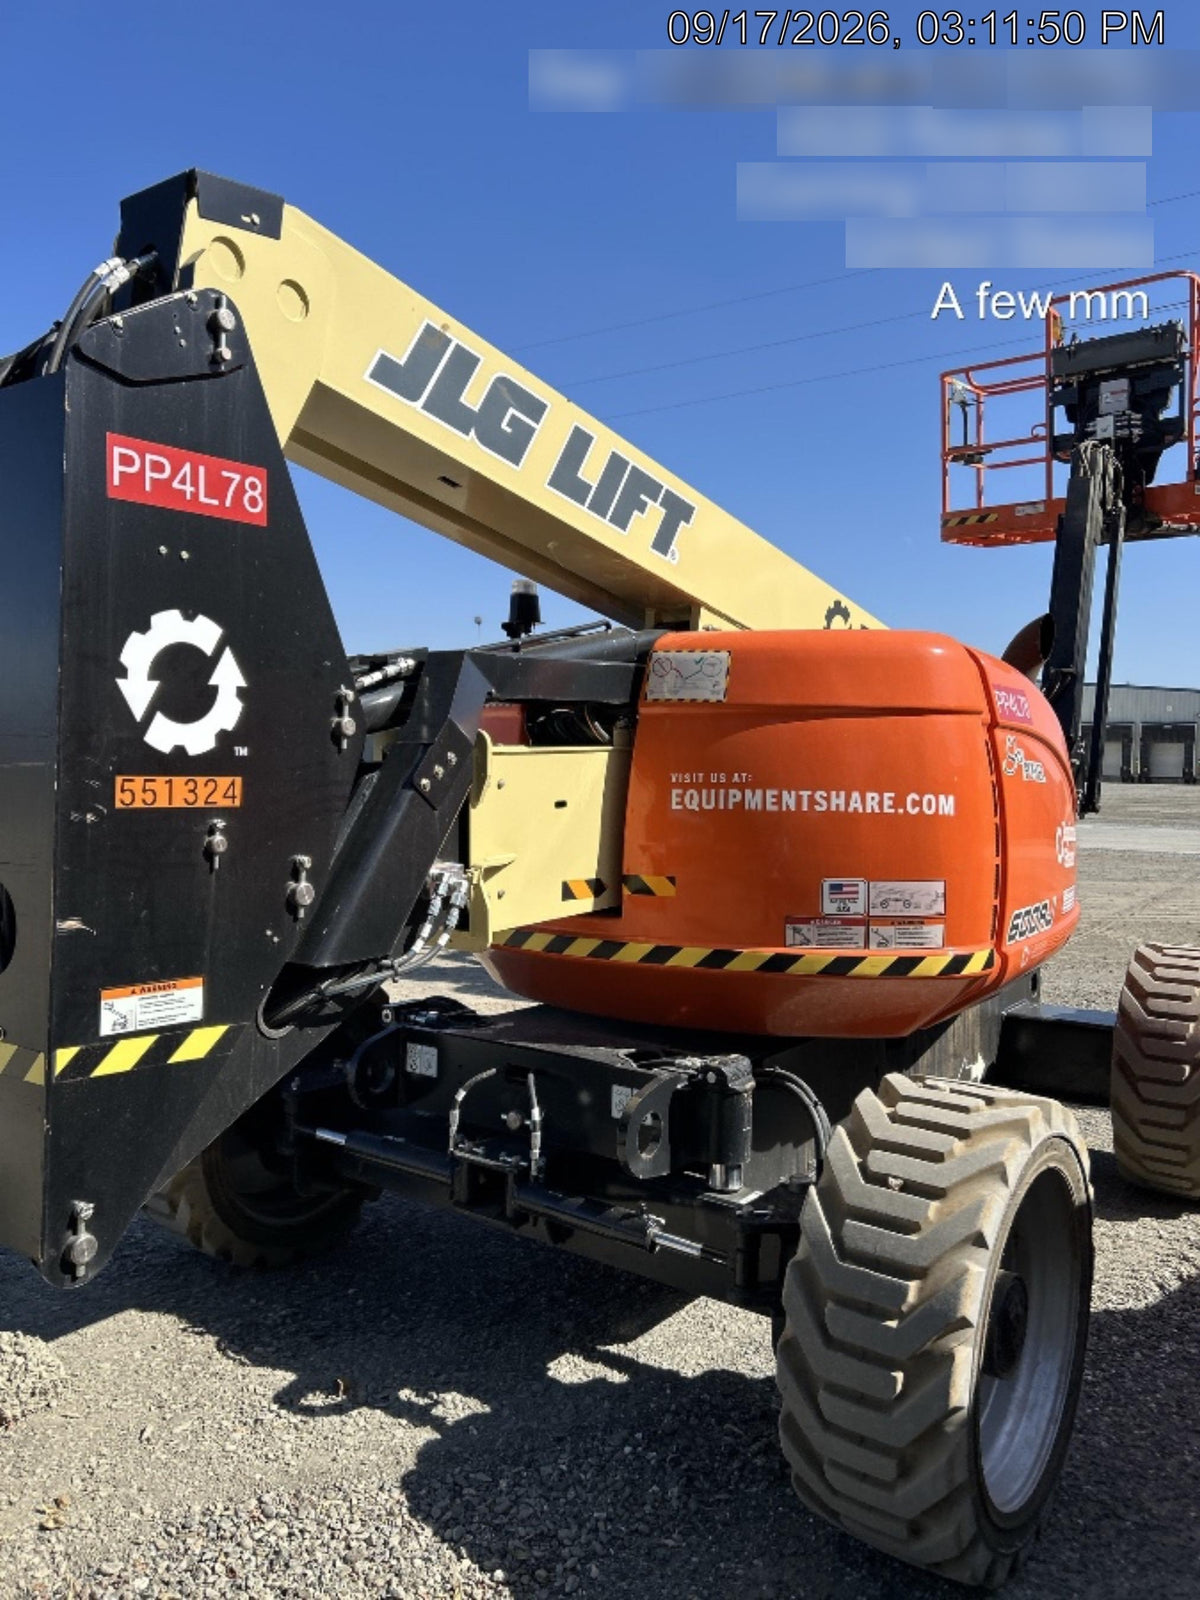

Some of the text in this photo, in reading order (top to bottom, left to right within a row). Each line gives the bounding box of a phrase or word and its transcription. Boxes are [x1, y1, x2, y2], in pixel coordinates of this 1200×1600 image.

[363, 318, 550, 472] JLG
[112, 445, 263, 514] PP4L78
[670, 772, 752, 783] VISIT US AT:
[119, 778, 237, 806] 551324
[670, 788, 955, 816] EQUIPMENTSHARE.COM
